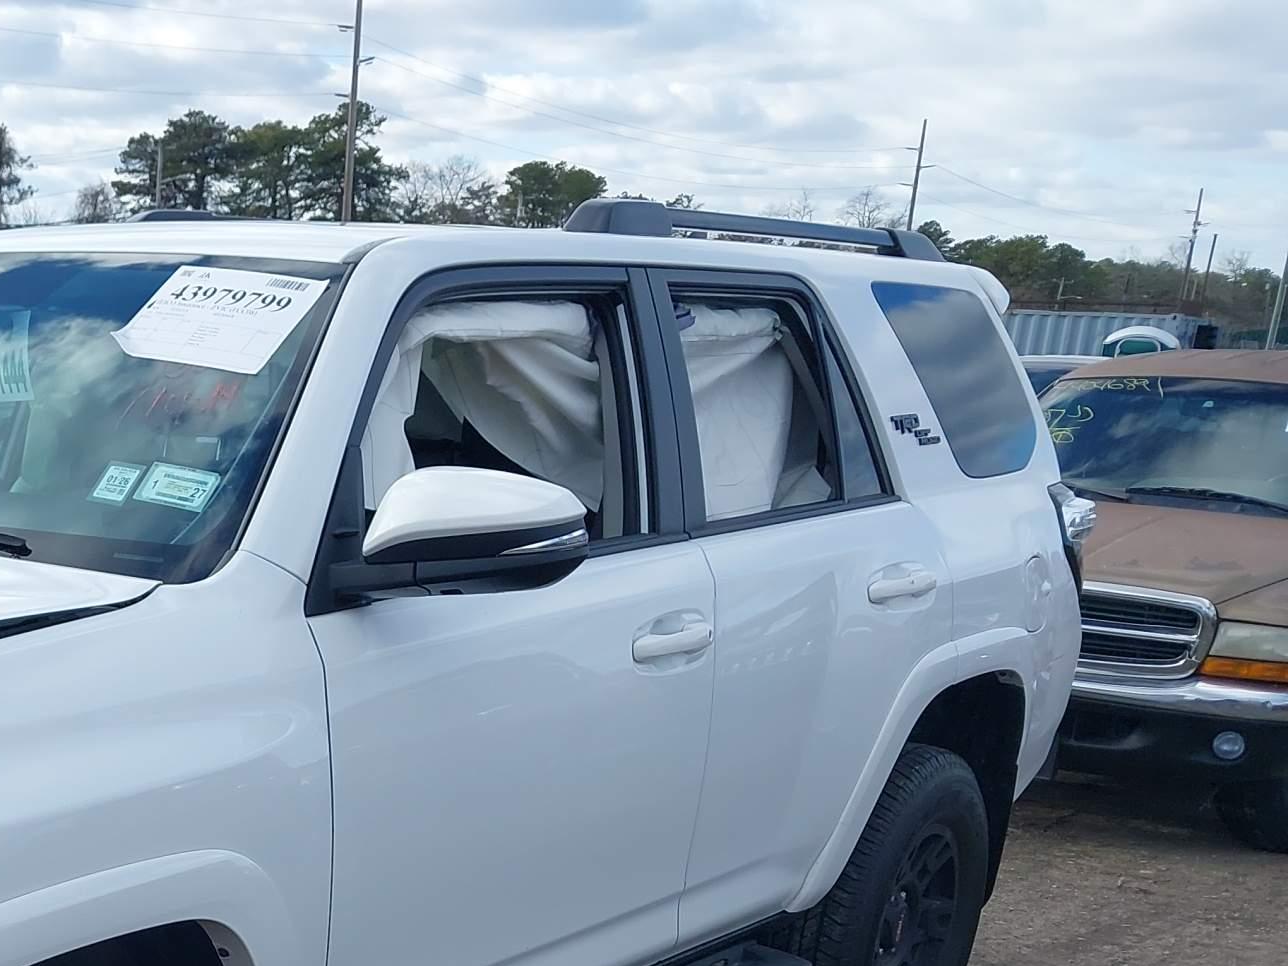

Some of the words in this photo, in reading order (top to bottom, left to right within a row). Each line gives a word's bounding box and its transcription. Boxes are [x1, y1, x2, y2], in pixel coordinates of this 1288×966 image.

[170, 283, 293, 312] 43979799
[889, 413, 920, 435] TRD
[189, 487, 208, 499] 27
